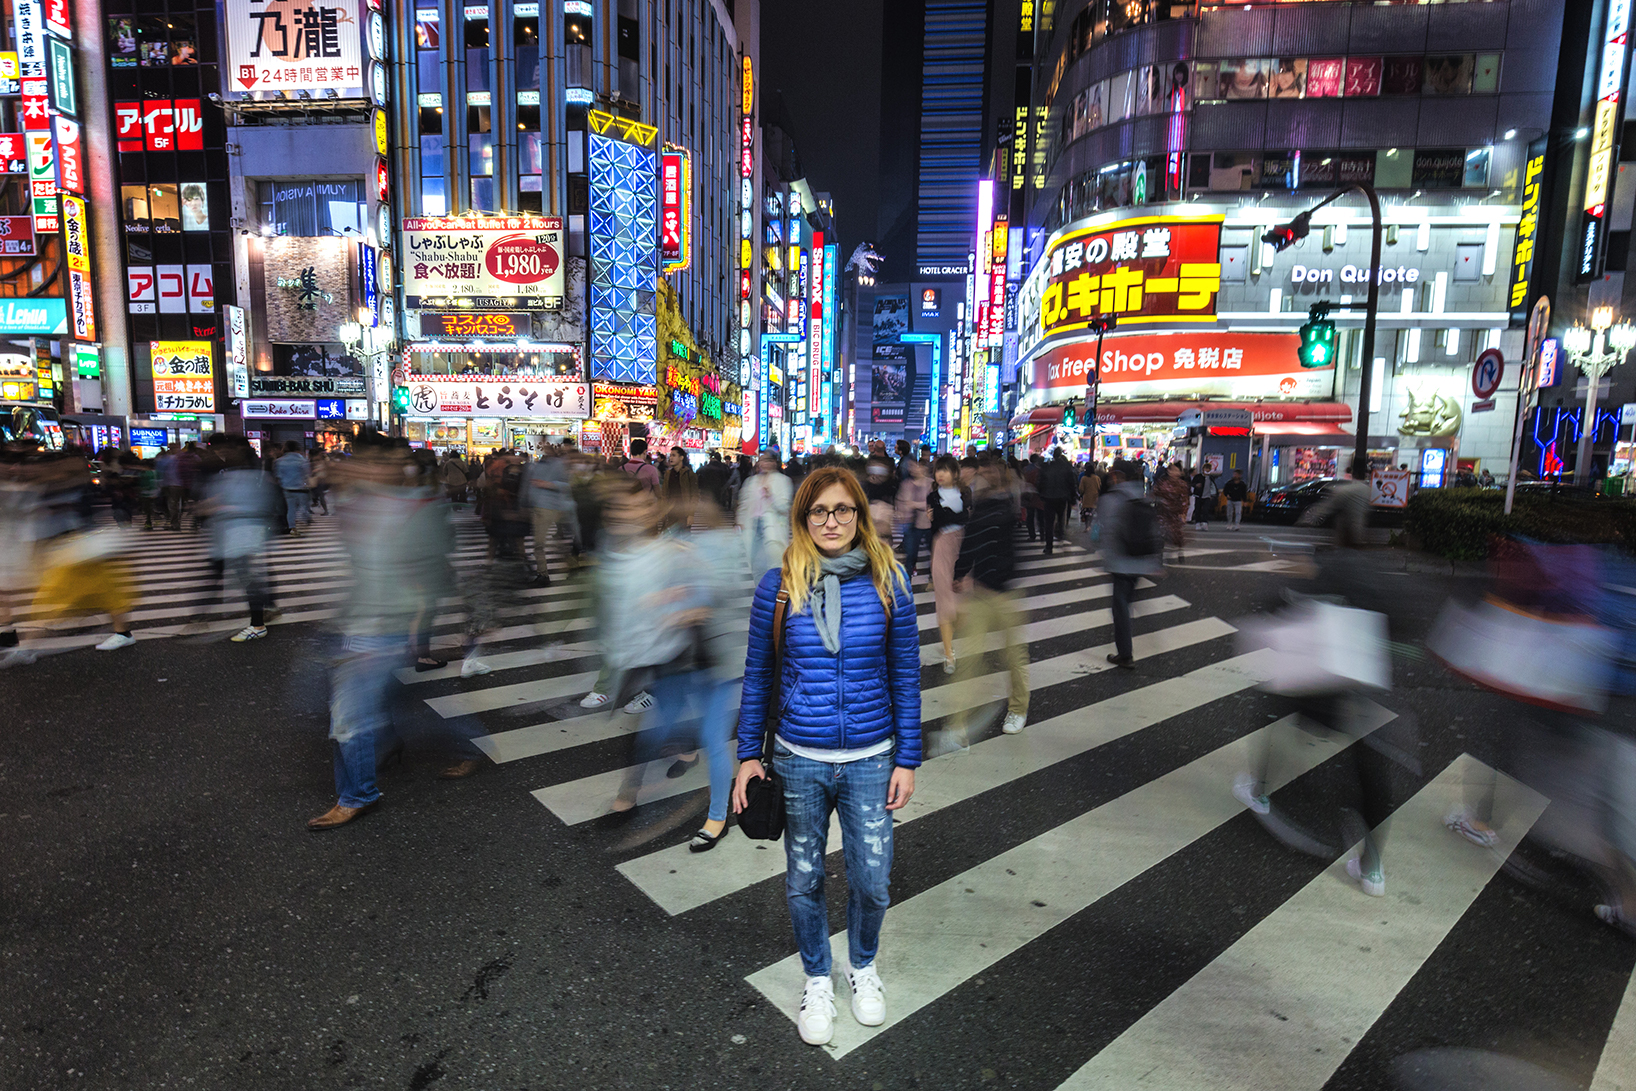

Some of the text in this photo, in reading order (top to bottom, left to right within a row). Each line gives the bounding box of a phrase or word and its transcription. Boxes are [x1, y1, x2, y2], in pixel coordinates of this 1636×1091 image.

[1021, 0, 1033, 31] 殿堂
[241, 68, 255, 79] B1
[262, 66, 359, 83] 24時間営業中
[24, 98, 49, 118] 本
[117, 108, 203, 133] アイフル
[154, 138, 169, 148] 5F
[9, 160, 24, 173] 4F
[37, 218, 58, 229] 銀行
[507, 220, 521, 229] for
[524, 220, 530, 229] 2
[533, 220, 559, 229] hours
[20, 241, 32, 252] 4F
[410, 235, 484, 250] しゃぶしゃぶ
[73, 257, 85, 267] 2F
[495, 254, 541, 278] 1,980
[814, 249, 824, 304] SHIDAX
[1292, 265, 1419, 286] Don Qujote
[130, 273, 213, 299] アコム
[544, 297, 562, 309] 5F
[445, 325, 516, 335] キャンパスコース
[812, 342, 820, 366] DRUG
[1173, 348, 1243, 370] 免税店
[169, 356, 211, 375] 金の蔵
[1062, 357, 1096, 377] Free
[1101, 350, 1164, 375] Shop
[413, 385, 436, 411] 虎
[476, 385, 570, 411] とらそば
[595, 386, 658, 397] OKONOMI YAKI
[164, 395, 213, 409] チカラめし
[1254, 411, 1284, 421] uijote
[1426, 454, 1436, 466] P
